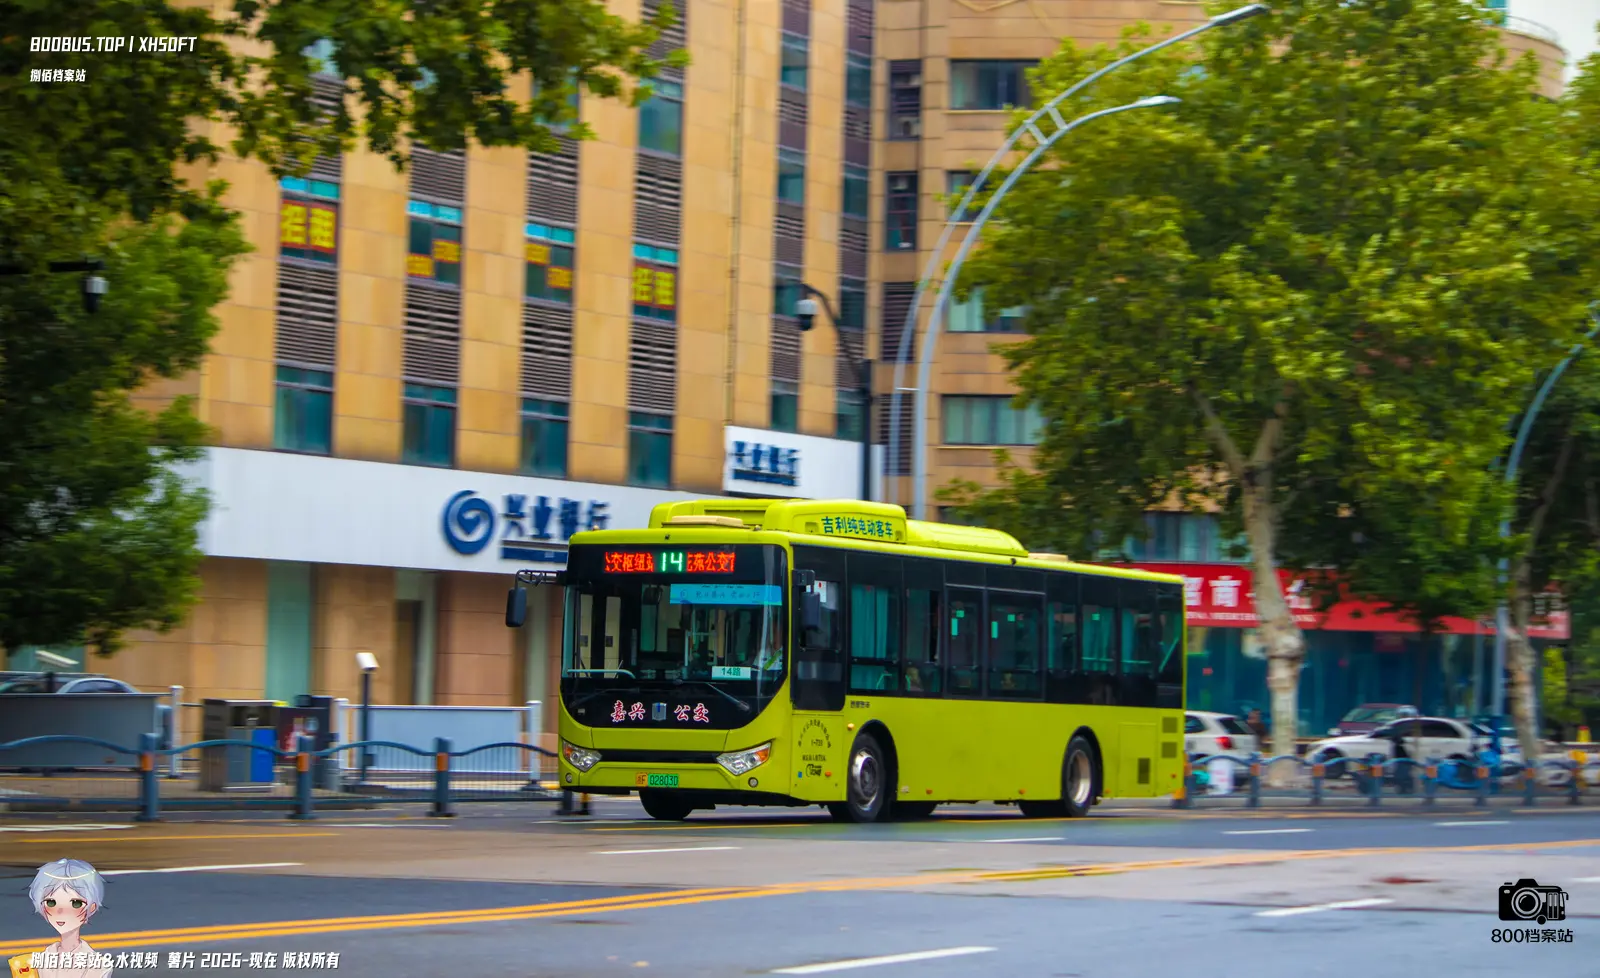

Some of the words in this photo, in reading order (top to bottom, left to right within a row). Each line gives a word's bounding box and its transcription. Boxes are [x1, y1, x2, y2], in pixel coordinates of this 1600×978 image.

[821, 516, 893, 537] 吉利纯电动客车
[661, 552, 683, 572] 14
[721, 667, 741, 677] 14路
[611, 700, 645, 722] 嘉兴
[674, 703, 709, 722] 公交
[650, 775, 678, 786] 02803D
